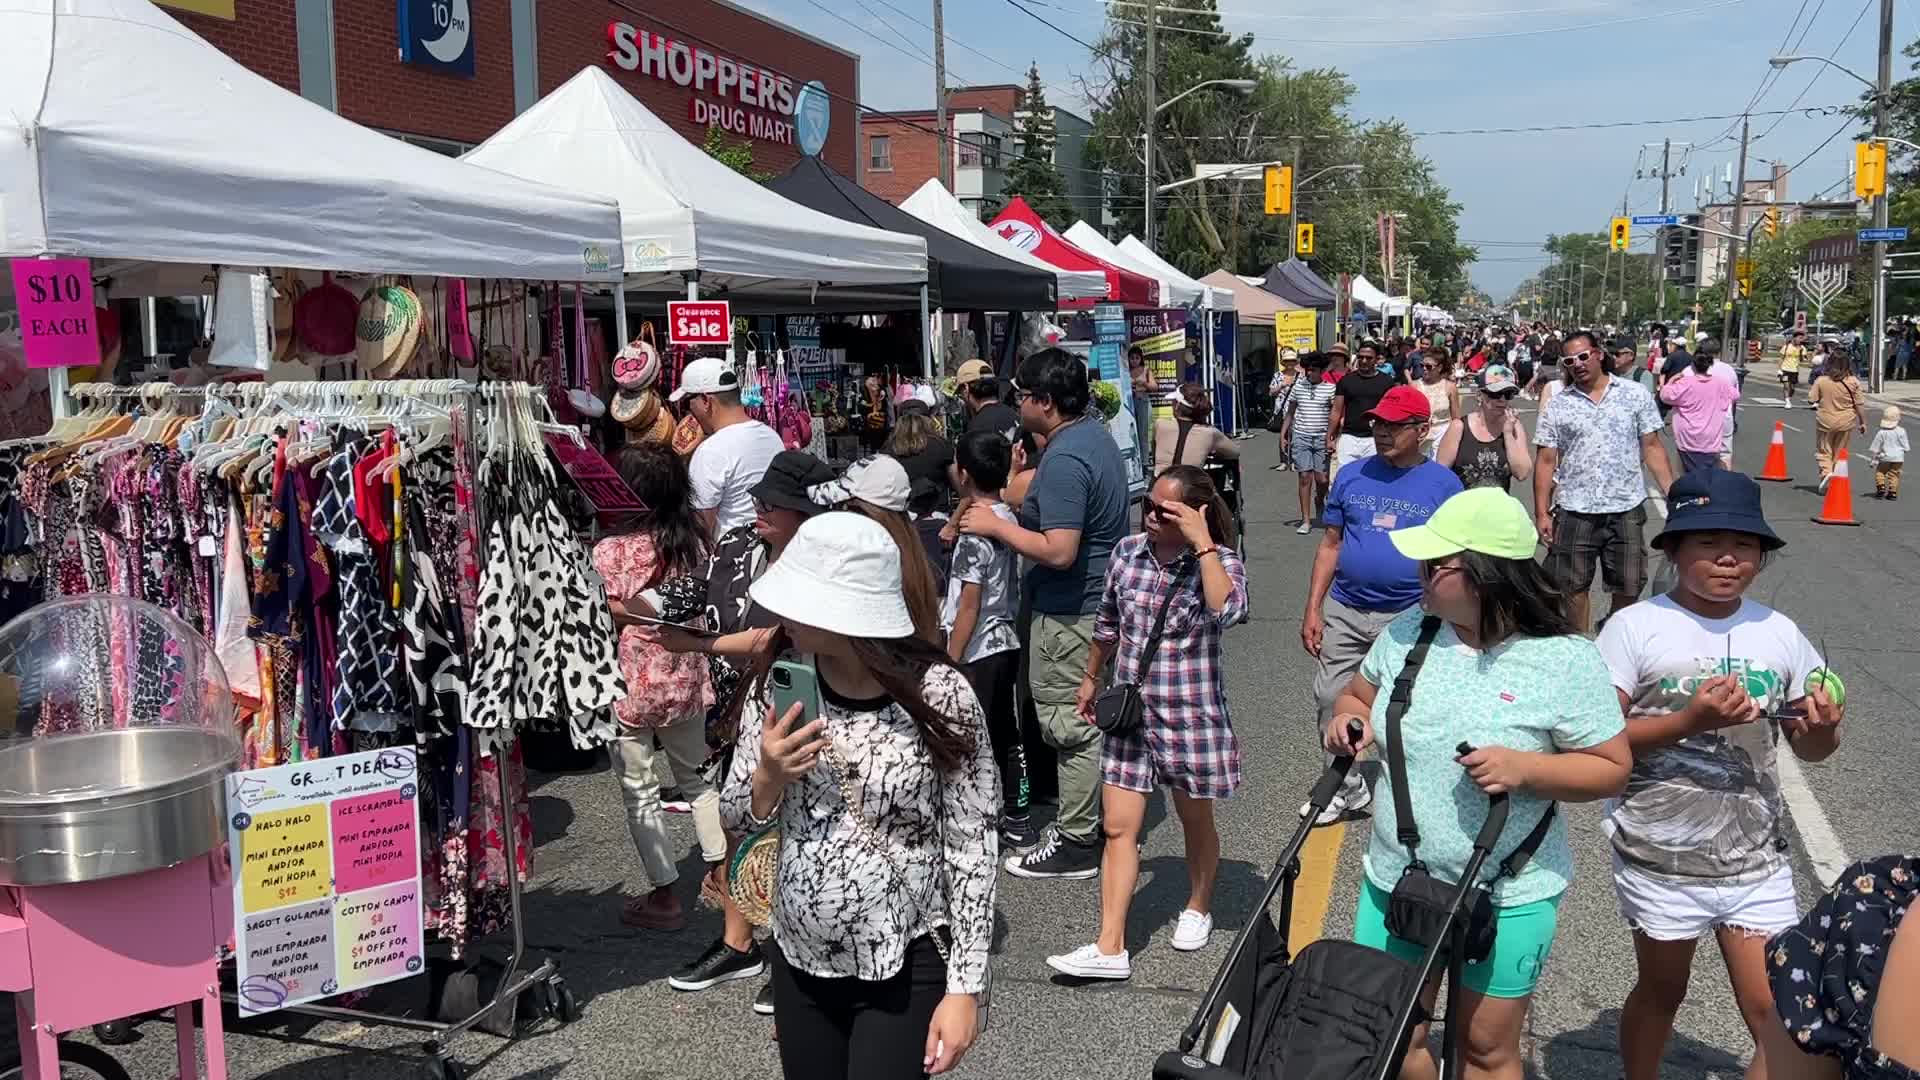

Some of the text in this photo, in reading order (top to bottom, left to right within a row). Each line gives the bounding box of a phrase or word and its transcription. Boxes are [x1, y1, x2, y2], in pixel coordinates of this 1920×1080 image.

[432, 3, 448, 28] 10
[452, 17, 465, 32] PM
[608, 21, 795, 116] SHOPPERS
[692, 98, 794, 145] DRUG MART
[28, 273, 81, 304] $10
[676, 307, 721, 317] Clearance
[1133, 315, 1157, 326] FREE
[31, 318, 88, 336] EACH
[677, 317, 721, 337] Sale
[1132, 326, 1162, 335] GRANTS
[1350, 494, 1377, 505] LAS
[1381, 496, 1430, 517] VEGAS
[291, 756, 402, 787] GRT DEALS
[338, 799, 404, 816] ICE SCRAMBLE
[256, 814, 311, 831] HALO HALO
[339, 822, 410, 844] MINI EMPANADA
[246, 840, 324, 862] MINI EMPANADA
[360, 839, 395, 853] AND/OR
[268, 858, 305, 873] AND/OR
[353, 850, 402, 868] MINI HOPIA
[261, 869, 316, 888] MINI HOPIA
[278, 886, 297, 899] $12
[341, 893, 414, 916] COTTON CANDY
[284, 908, 330, 923] GULAMAN
[358, 924, 397, 942] AND GET
[250, 934, 327, 958] MINI EMPANADA
[366, 941, 385, 953] OFF
[388, 937, 408, 948] FOR
[271, 952, 308, 967] AND/OR
[353, 951, 404, 970] EMPANADA
[265, 963, 319, 982] MINI HOPIA
